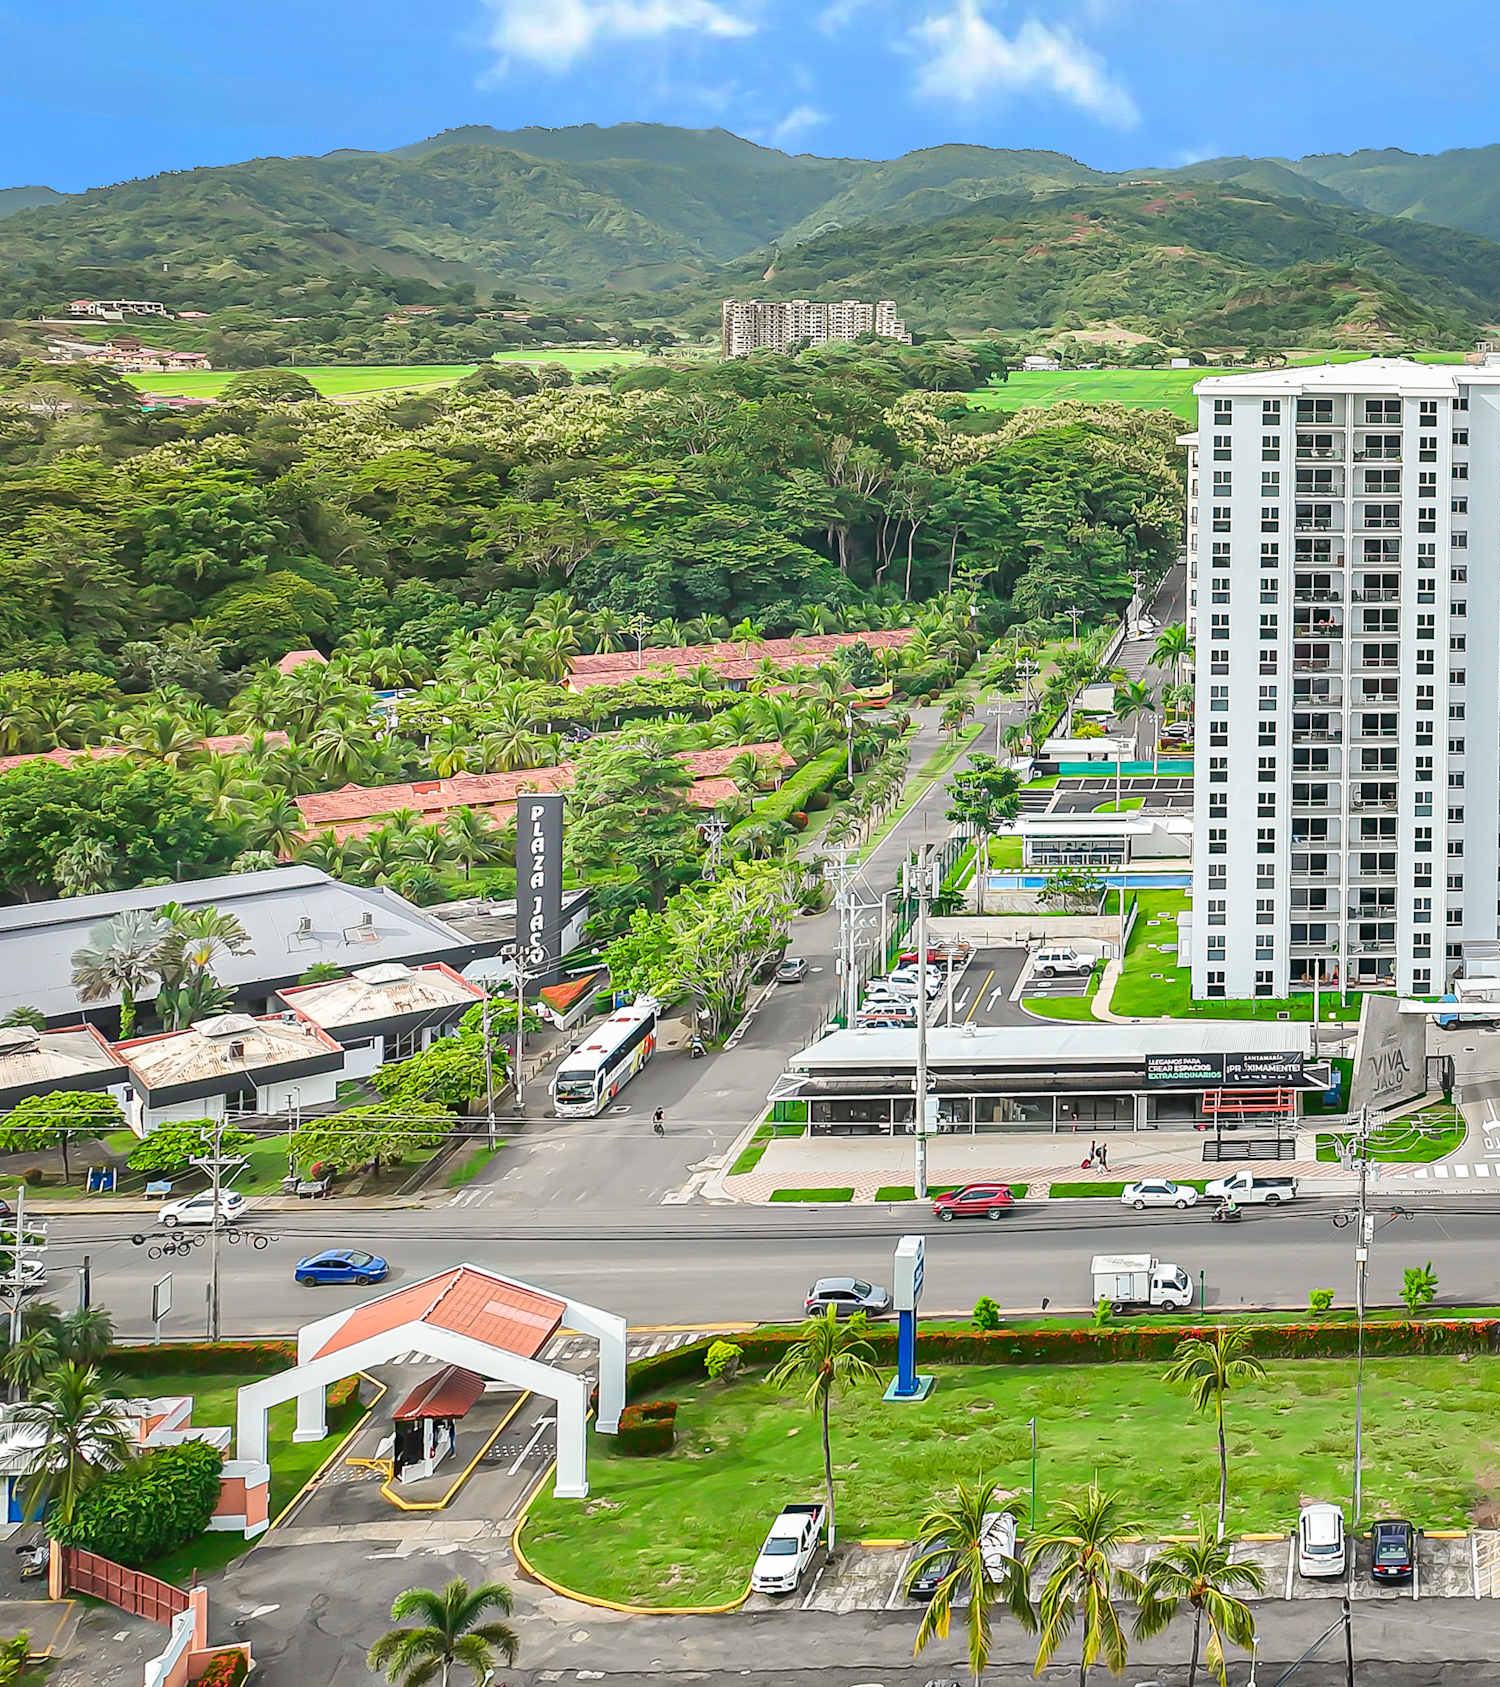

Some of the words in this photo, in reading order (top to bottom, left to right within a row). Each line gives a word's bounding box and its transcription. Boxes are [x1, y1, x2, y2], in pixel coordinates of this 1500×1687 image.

[531, 806, 544, 888] PLAZA
[1368, 1049, 1410, 1075] VIVA
[1148, 1071, 1222, 1080] EXTRAORDINARIOS
